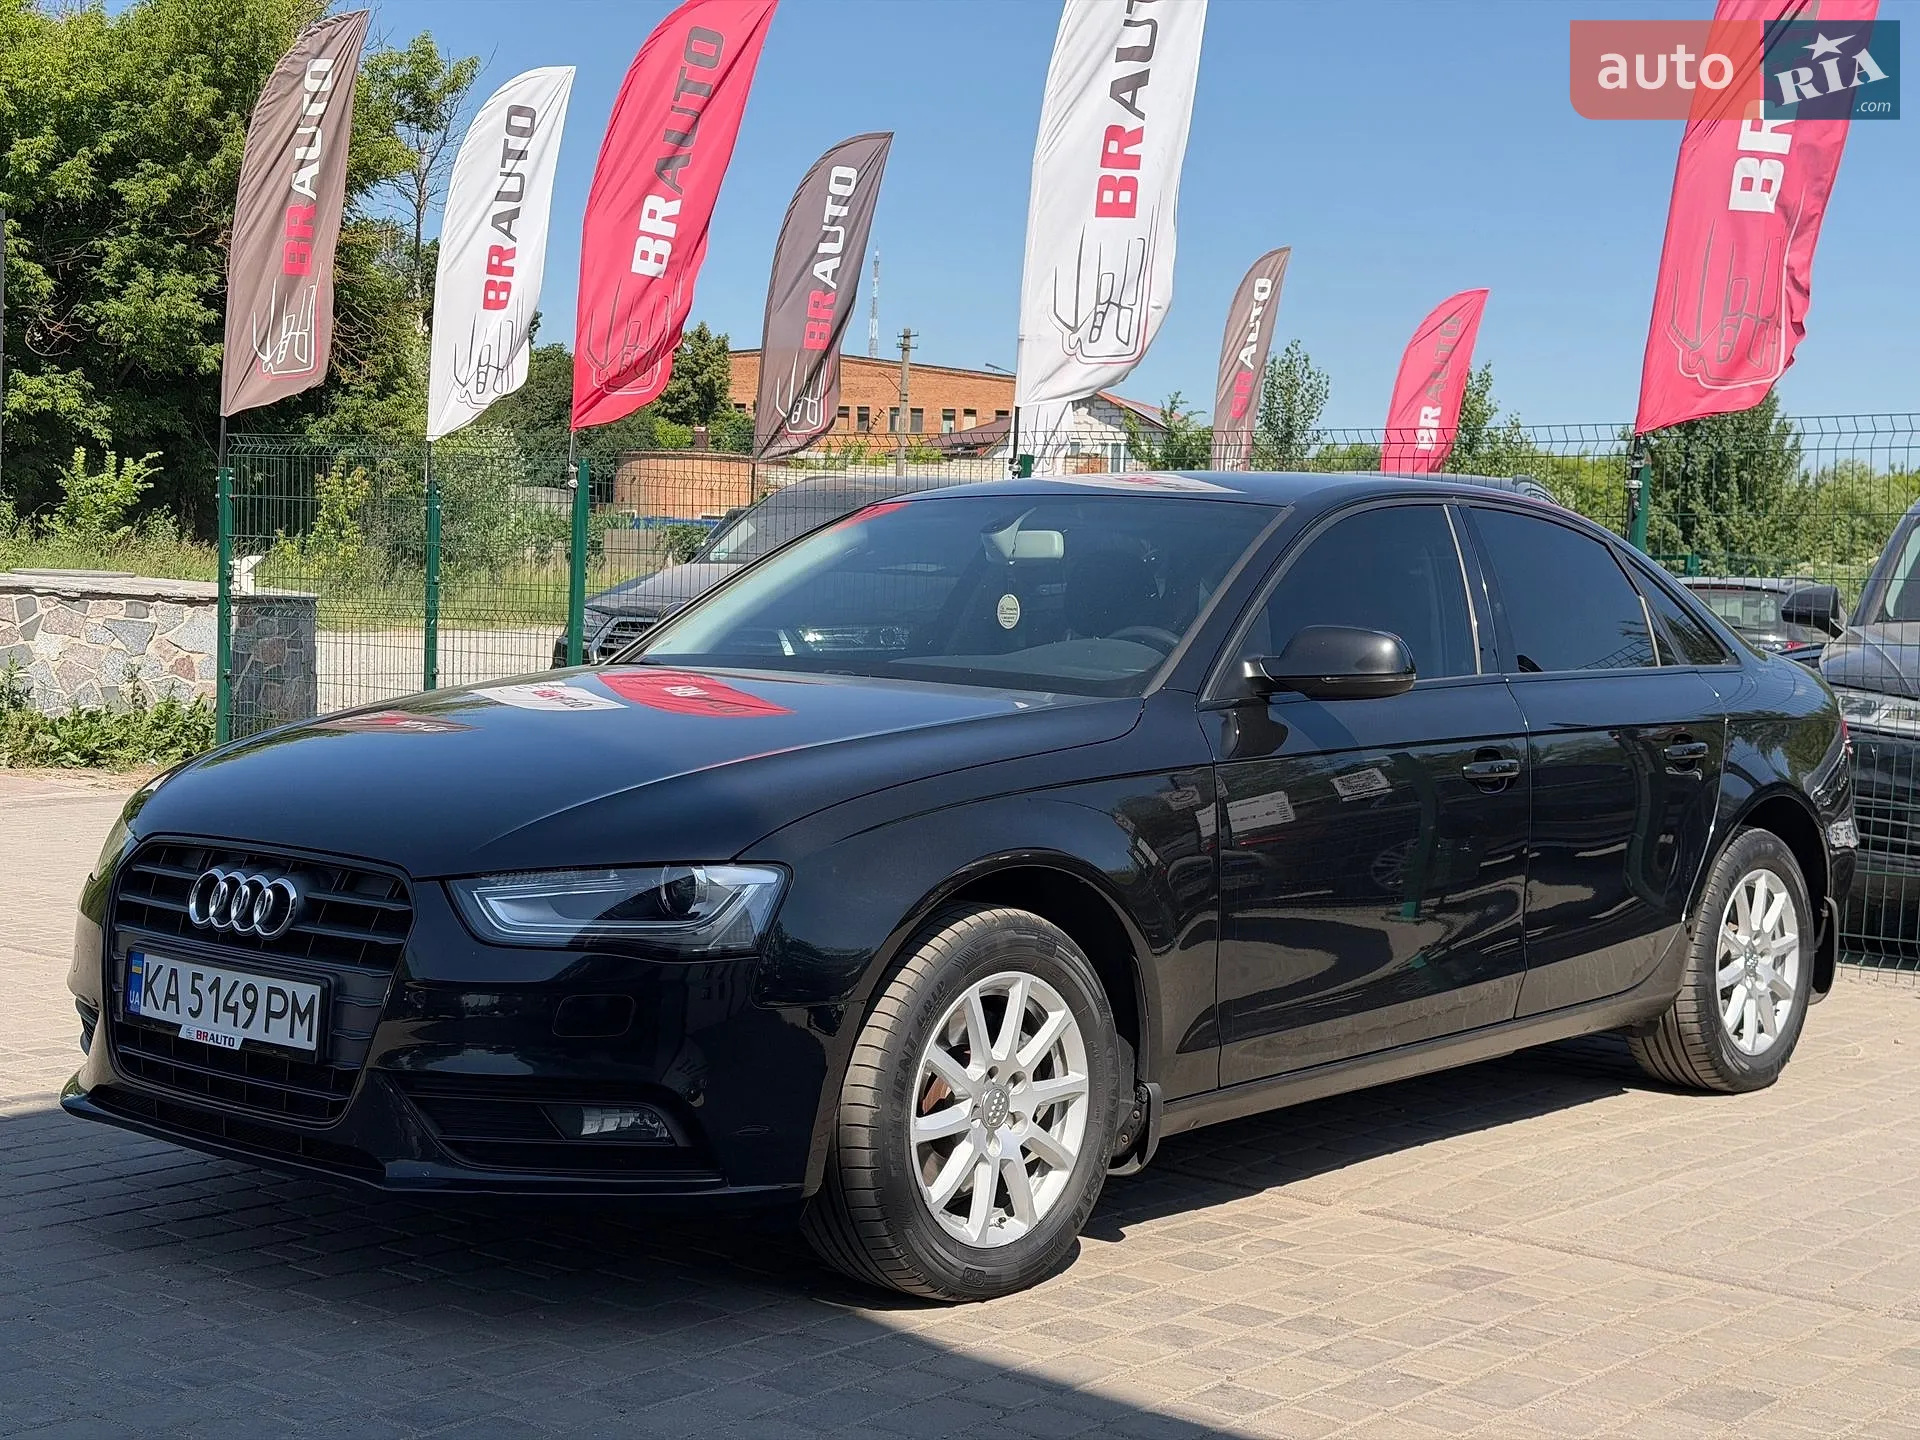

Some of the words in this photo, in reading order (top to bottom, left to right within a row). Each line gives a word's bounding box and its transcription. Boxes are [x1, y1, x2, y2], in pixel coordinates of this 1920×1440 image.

[281, 57, 334, 277] BRAUTO
[483, 103, 538, 311] BRAUTO
[630, 25, 726, 280] BRAUTO
[803, 165, 858, 351] BRAUTO
[1415, 316, 1462, 452] BRAUTO
[129, 991, 141, 1006] UA
[195, 1030, 235, 1047] BRAUTO
